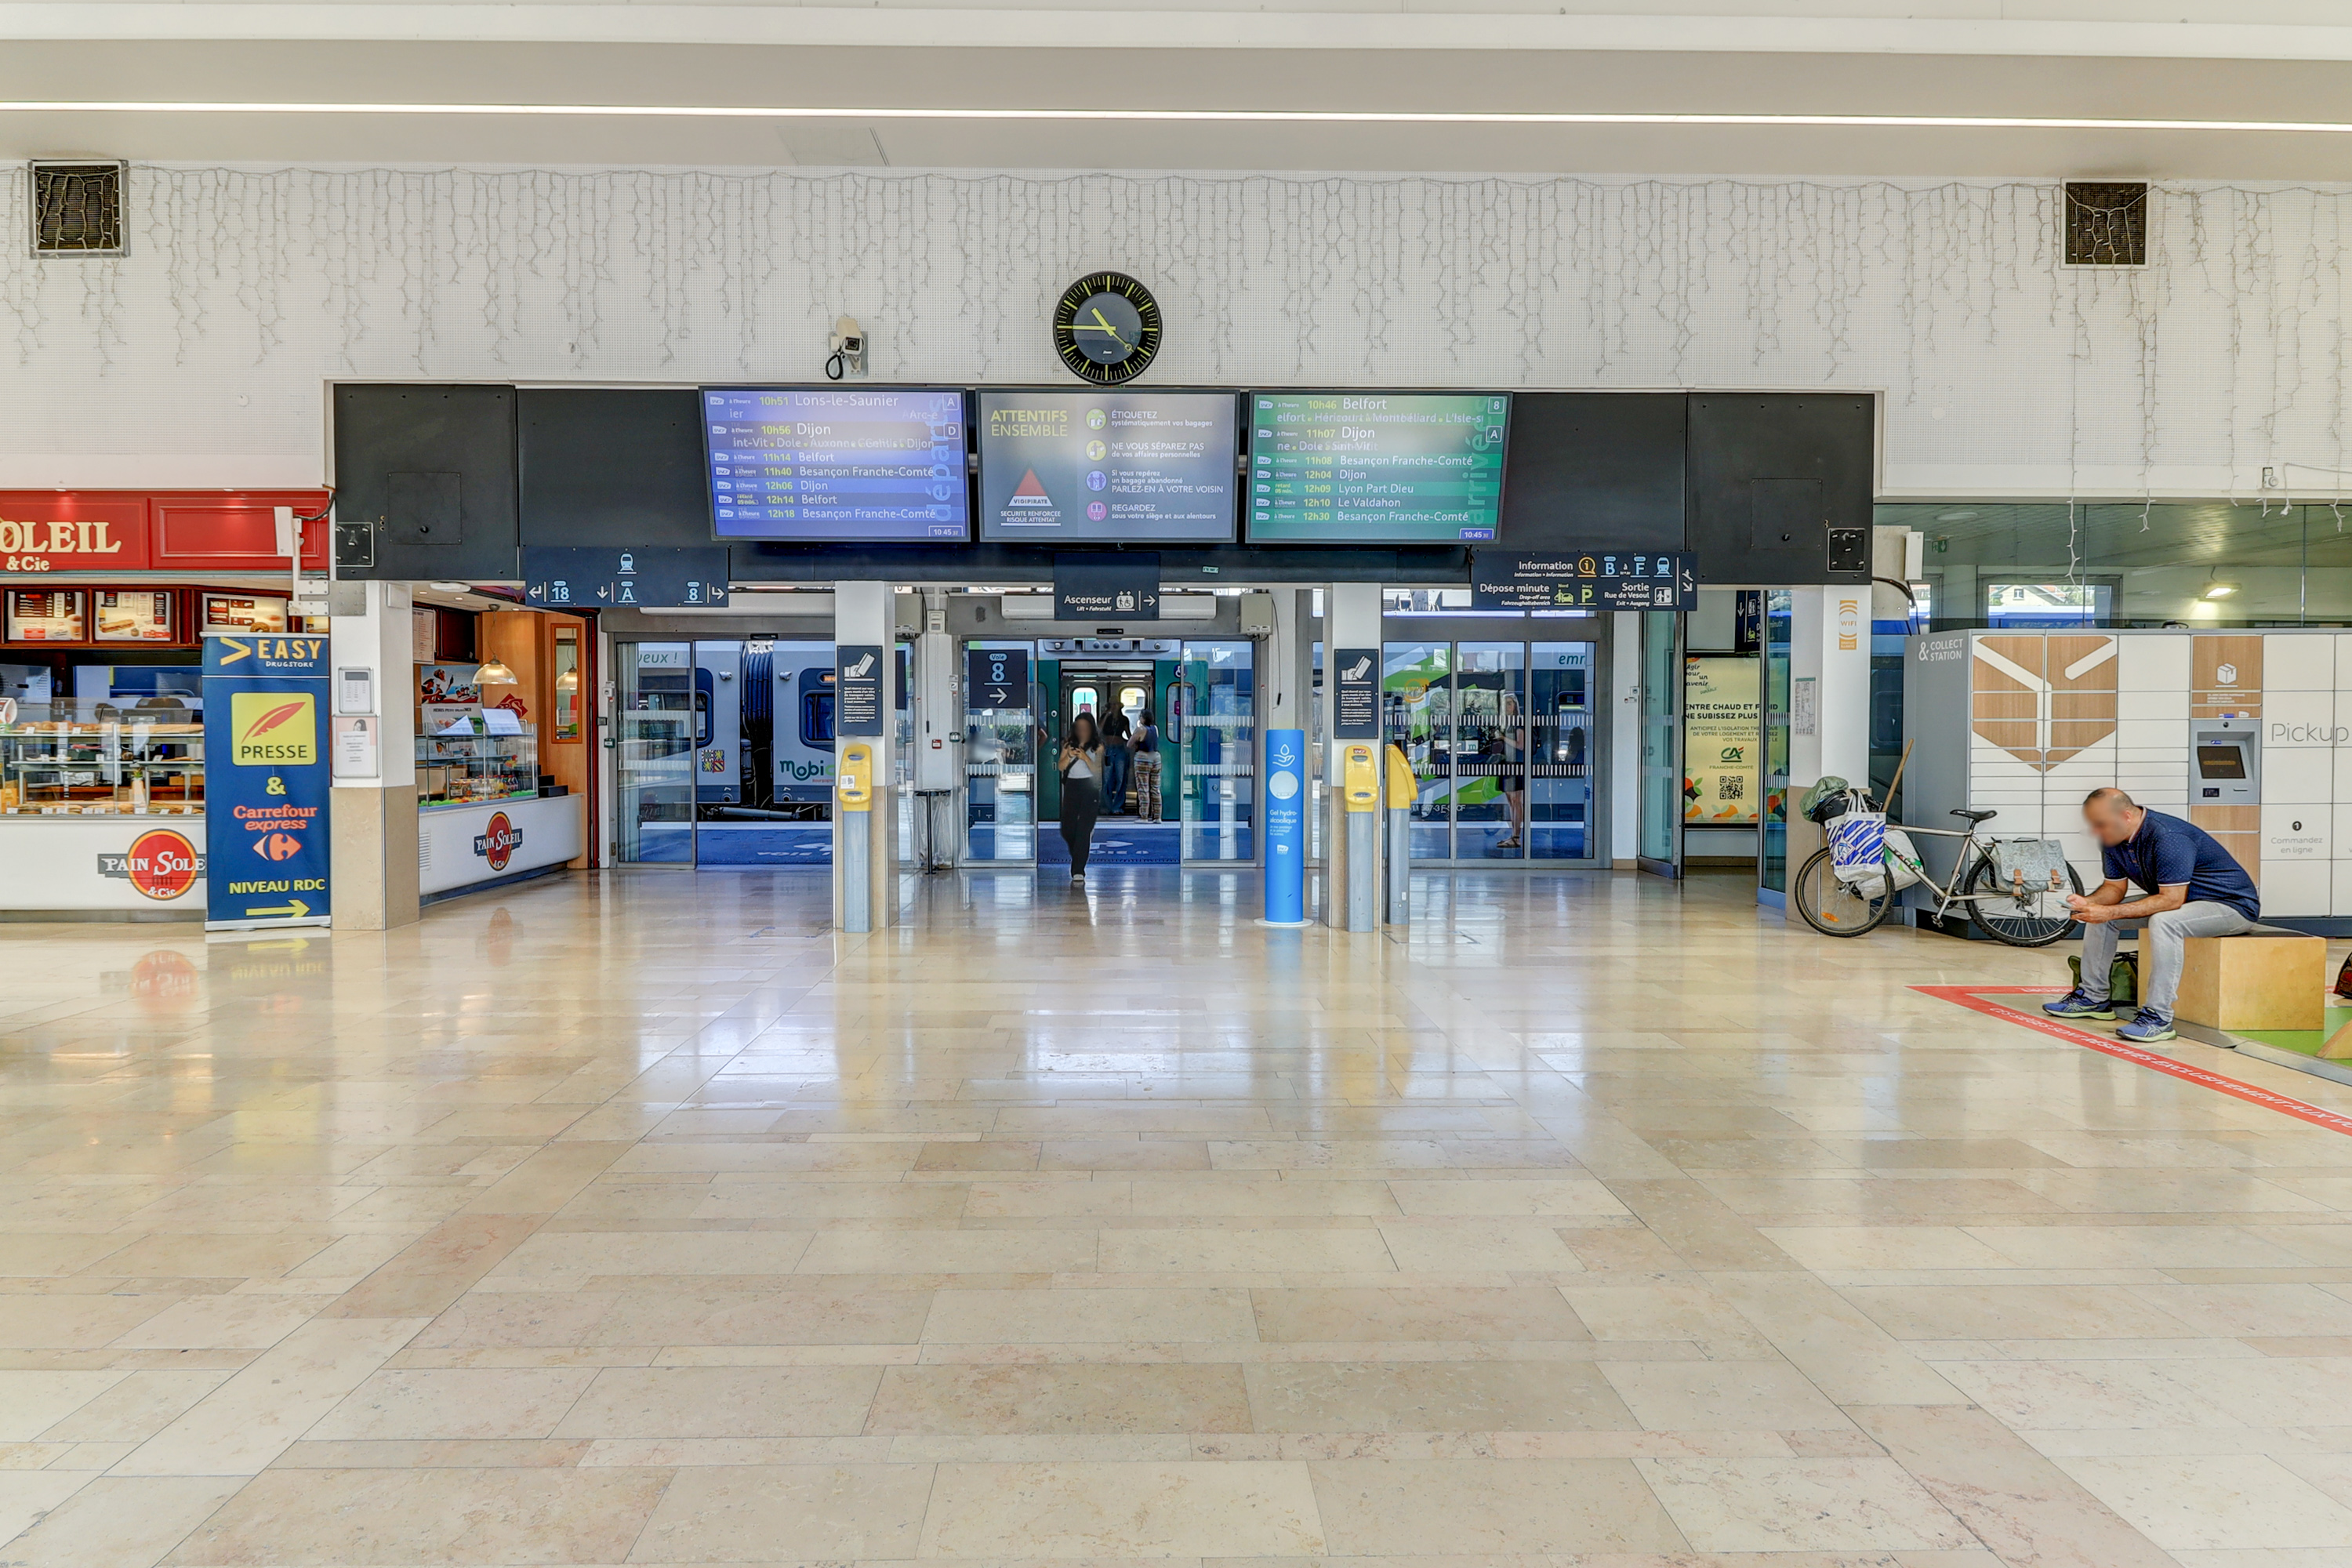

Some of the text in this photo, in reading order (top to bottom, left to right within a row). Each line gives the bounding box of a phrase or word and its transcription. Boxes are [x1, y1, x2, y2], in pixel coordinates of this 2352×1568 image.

[759, 397, 789, 405] 10h51
[795, 394, 898, 406] Lons-le-Saunier
[947, 397, 955, 406] A
[1308, 401, 1337, 409] 10h46
[1343, 397, 1387, 409] Belfort
[1494, 401, 1500, 410] 8
[990, 410, 1068, 422] ATTENTIFS
[1111, 410, 1158, 419] ÉTIQUETEZ
[761, 423, 956, 437] 10h56 Dijon D
[992, 424, 1068, 437] ENSEMBLE
[1307, 426, 1498, 441] 11h07 Dijon A
[733, 437, 935, 450] int-Vit Dole Dijon
[1151, 441, 1186, 450] SÉPAREZ
[1299, 441, 1323, 451] Dole
[764, 452, 834, 462] 11h14 Belfort
[1305, 456, 1472, 468] 11h08 Besançon Franche-Comté
[764, 466, 934, 478] 11h40 Besançon Franche-Comté
[1136, 470, 1160, 478] repérez
[1305, 470, 1367, 481] 12h04 Dijon
[765, 481, 828, 492] 12h06 Dijon
[1121, 477, 1145, 485] bagage
[1157, 484, 1165, 493] À
[1305, 484, 1414, 495] 12h09 Lyon Part Dieu
[767, 495, 837, 504] 12h14 Belfort
[1304, 498, 1401, 507] 12h10 Le Valdahon
[803, 509, 852, 521] Besançon
[855, 509, 935, 518] Franche-Comté
[1303, 511, 1468, 523] 12h30 Besançon Franche-Comté
[1519, 561, 1573, 570] Information
[1606, 562, 1615, 575] B
[1636, 562, 1645, 575] F
[1479, 583, 1514, 594] Dépose
[1516, 583, 1550, 592] minute
[1622, 583, 1650, 591] Sortie
[551, 587, 699, 601] 18 A 8
[1064, 595, 1112, 604] Ascenseur
[1581, 589, 1593, 603] P
[257, 639, 322, 660] EASY
[1930, 639, 1963, 651] COLLECT
[1930, 650, 1962, 662] STATION
[992, 662, 1005, 682] 8
[2270, 722, 2350, 746] Pickup
[241, 745, 308, 759] PRESSE
[266, 776, 286, 795] &
[233, 804, 318, 819] Carrefour
[1279, 809, 1298, 818] hydro-
[245, 819, 307, 833] express
[476, 829, 521, 851] PAIN SOLEIL
[2292, 846, 2313, 855] ligne
[101, 858, 150, 872] PAIN
[229, 879, 325, 894] NIVEAU RDC
[2151, 1059, 2294, 1107] EXCLUSIVEMENT
[2290, 1105, 2333, 1119] AUX
